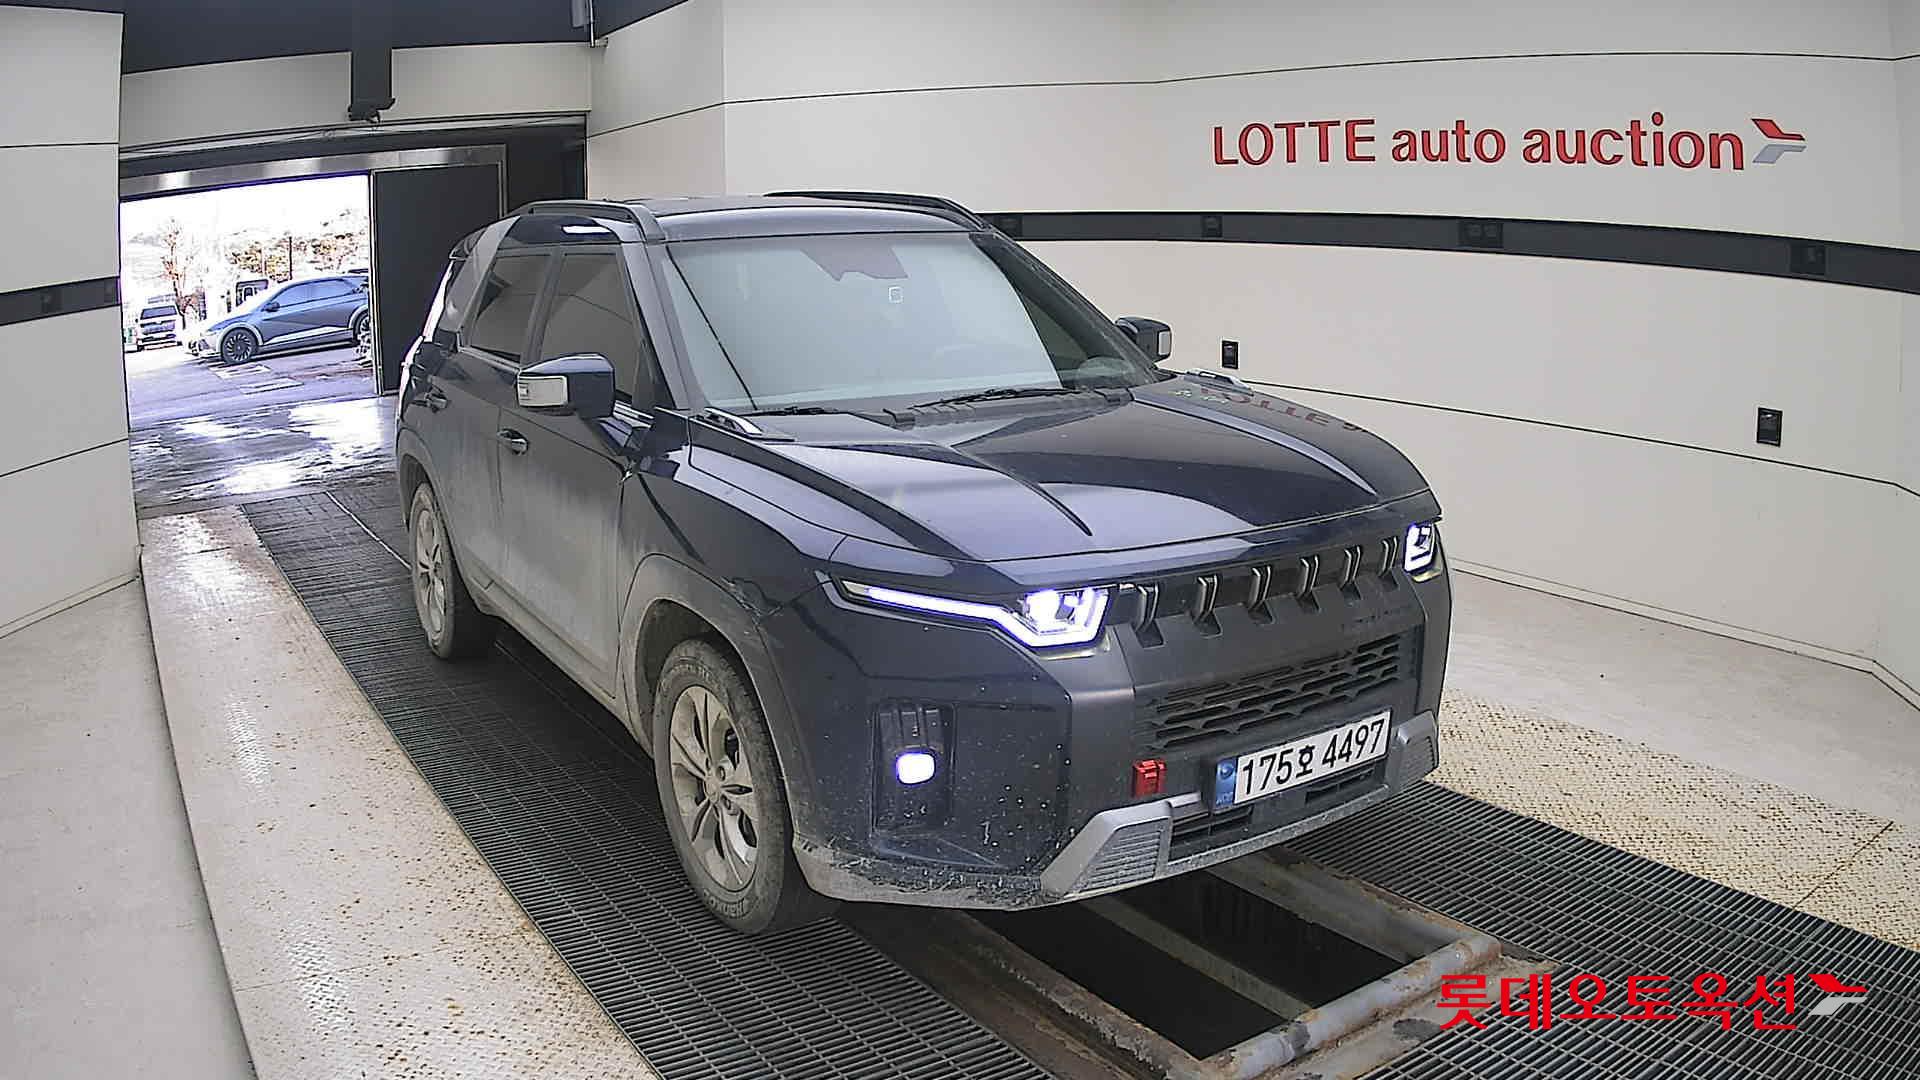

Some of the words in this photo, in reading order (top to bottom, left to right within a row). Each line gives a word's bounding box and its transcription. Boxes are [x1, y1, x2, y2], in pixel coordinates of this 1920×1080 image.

[1213, 118, 1376, 166] LOTTE
[1391, 119, 1508, 164] auto
[1522, 111, 1745, 171] auction
[1242, 744, 1315, 796] 175호
[1321, 718, 1385, 769] 4497
